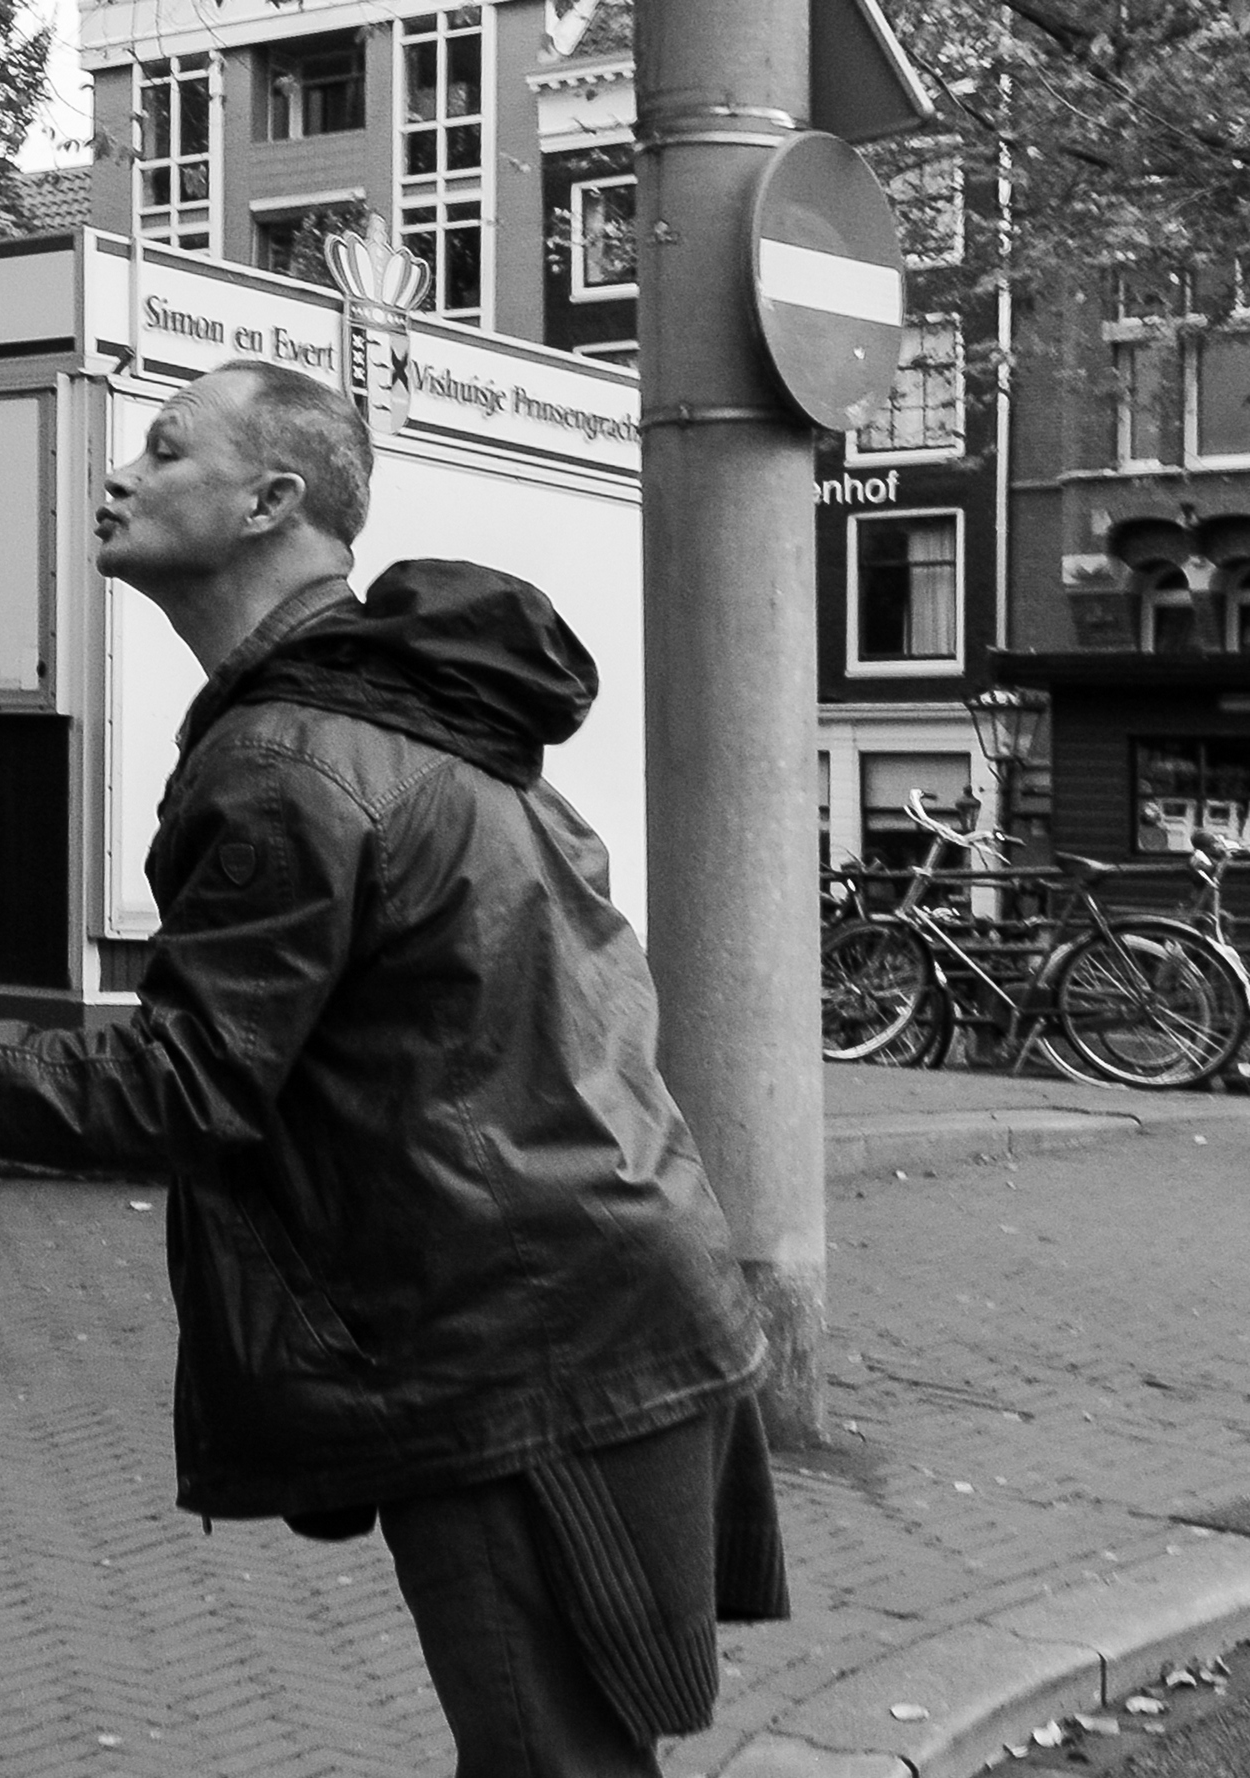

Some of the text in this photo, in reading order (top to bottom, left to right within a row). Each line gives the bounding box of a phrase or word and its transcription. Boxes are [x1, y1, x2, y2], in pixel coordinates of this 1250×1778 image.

[144, 295, 336, 372] Simon en Evert
[409, 358, 642, 444] Vishuisje Prinsengrach
